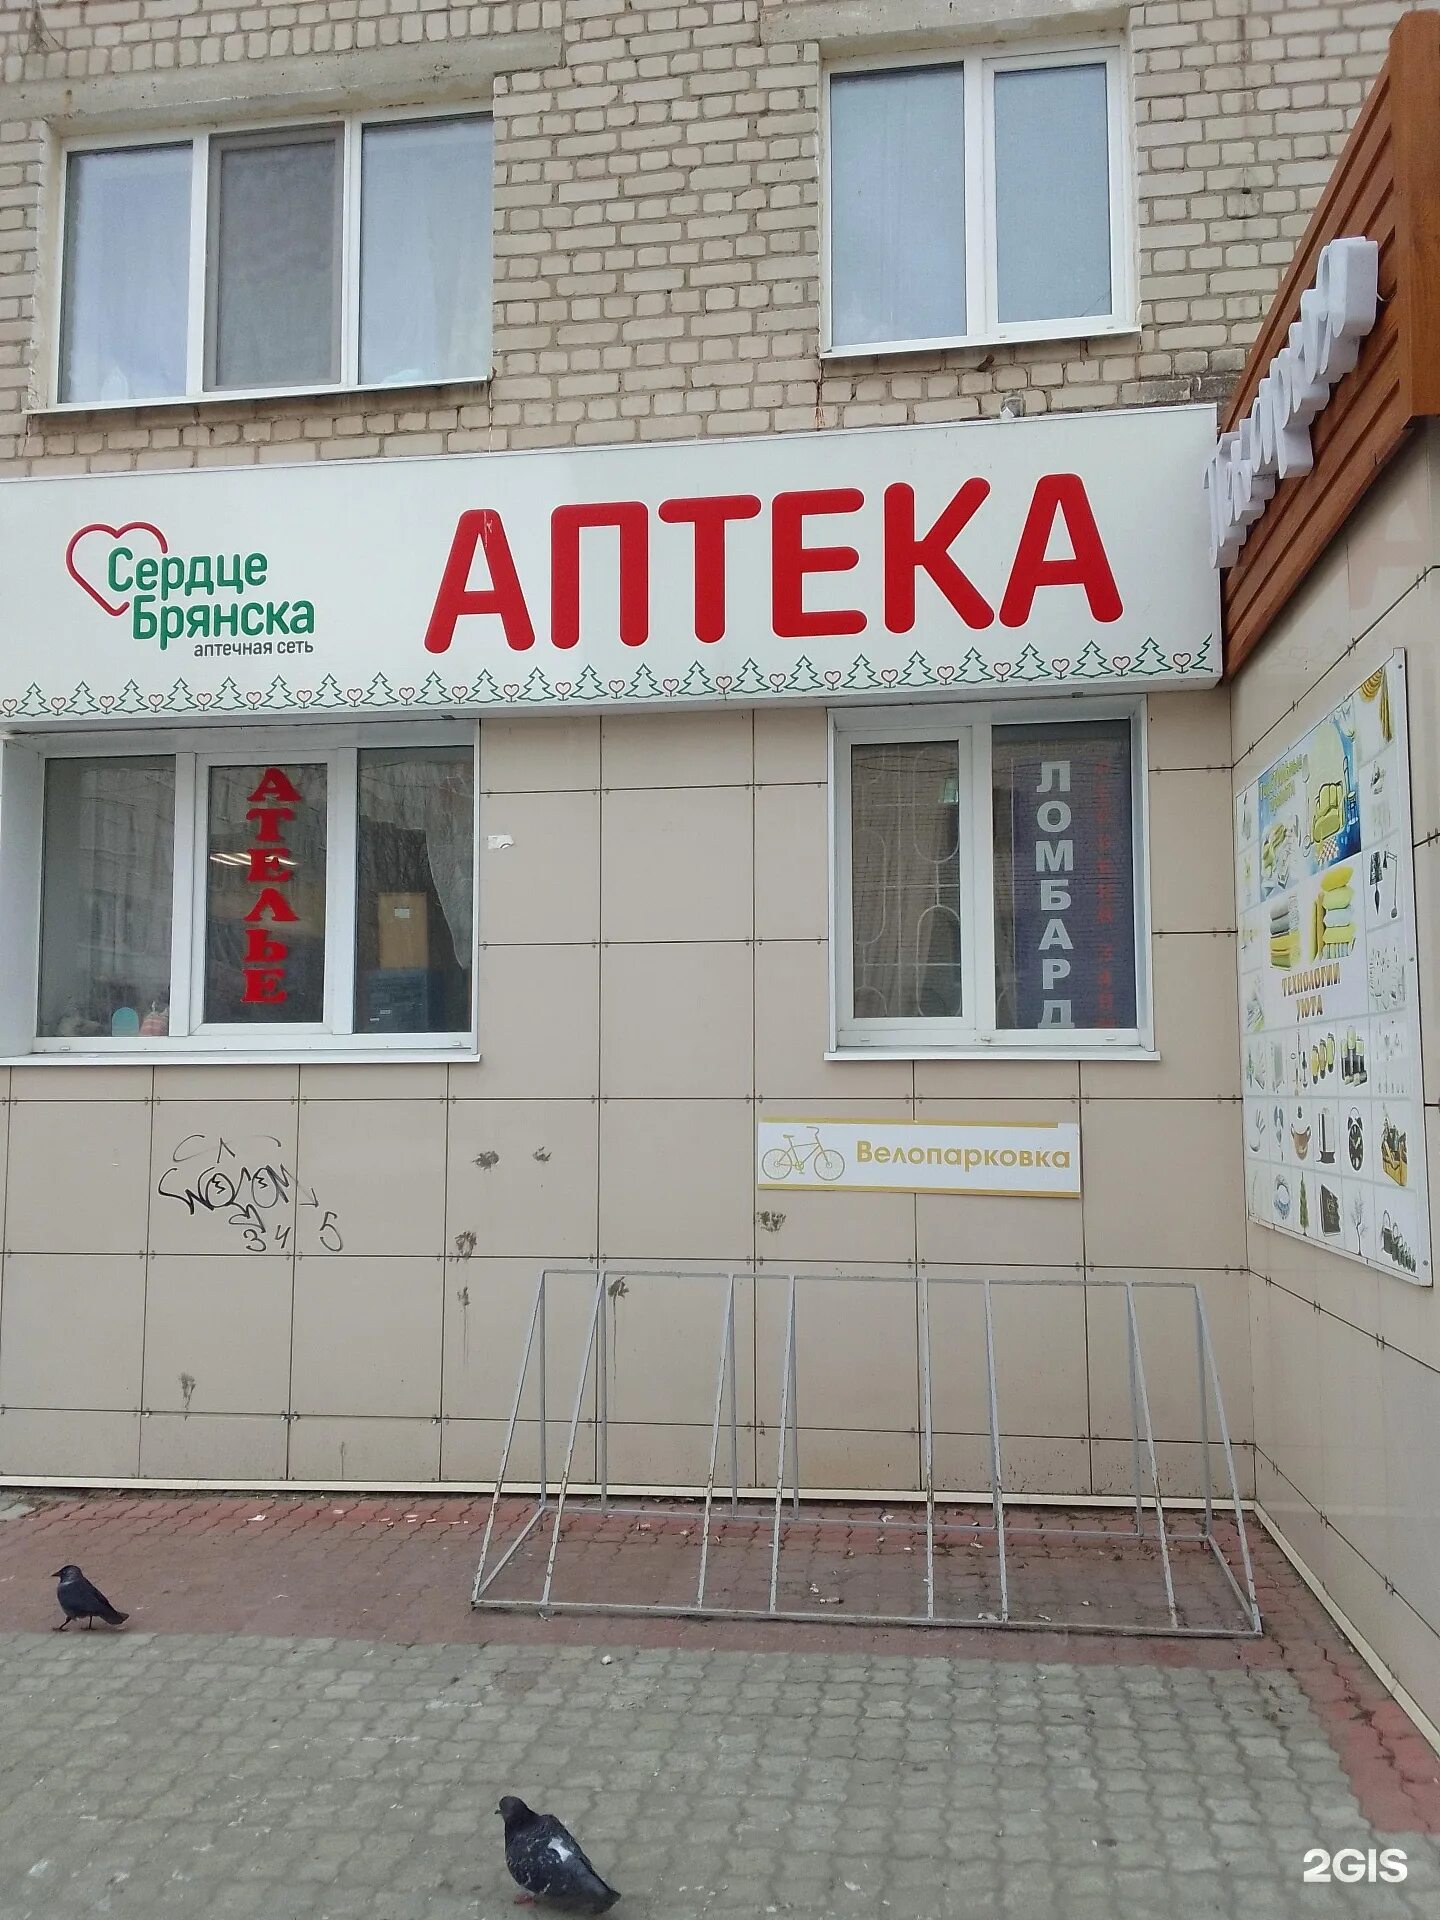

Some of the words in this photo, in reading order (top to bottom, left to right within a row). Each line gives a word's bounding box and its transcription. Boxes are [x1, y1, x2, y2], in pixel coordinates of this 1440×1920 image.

[108, 547, 268, 601] Сердце
[425, 473, 1123, 654] АПТЕКА
[132, 594, 315, 651] Брянска
[193, 641, 273, 657] аптечная
[276, 640, 314, 654] сеть
[242, 768, 302, 1005] АТЕЛЬЕ
[1035, 760, 1075, 1029] ЛОМБАРД
[1281, 962, 1341, 997] ТЕХНОЛОГИИ
[1295, 994, 1324, 1023] УЮТА
[856, 1140, 1071, 1172] Велопарковка
